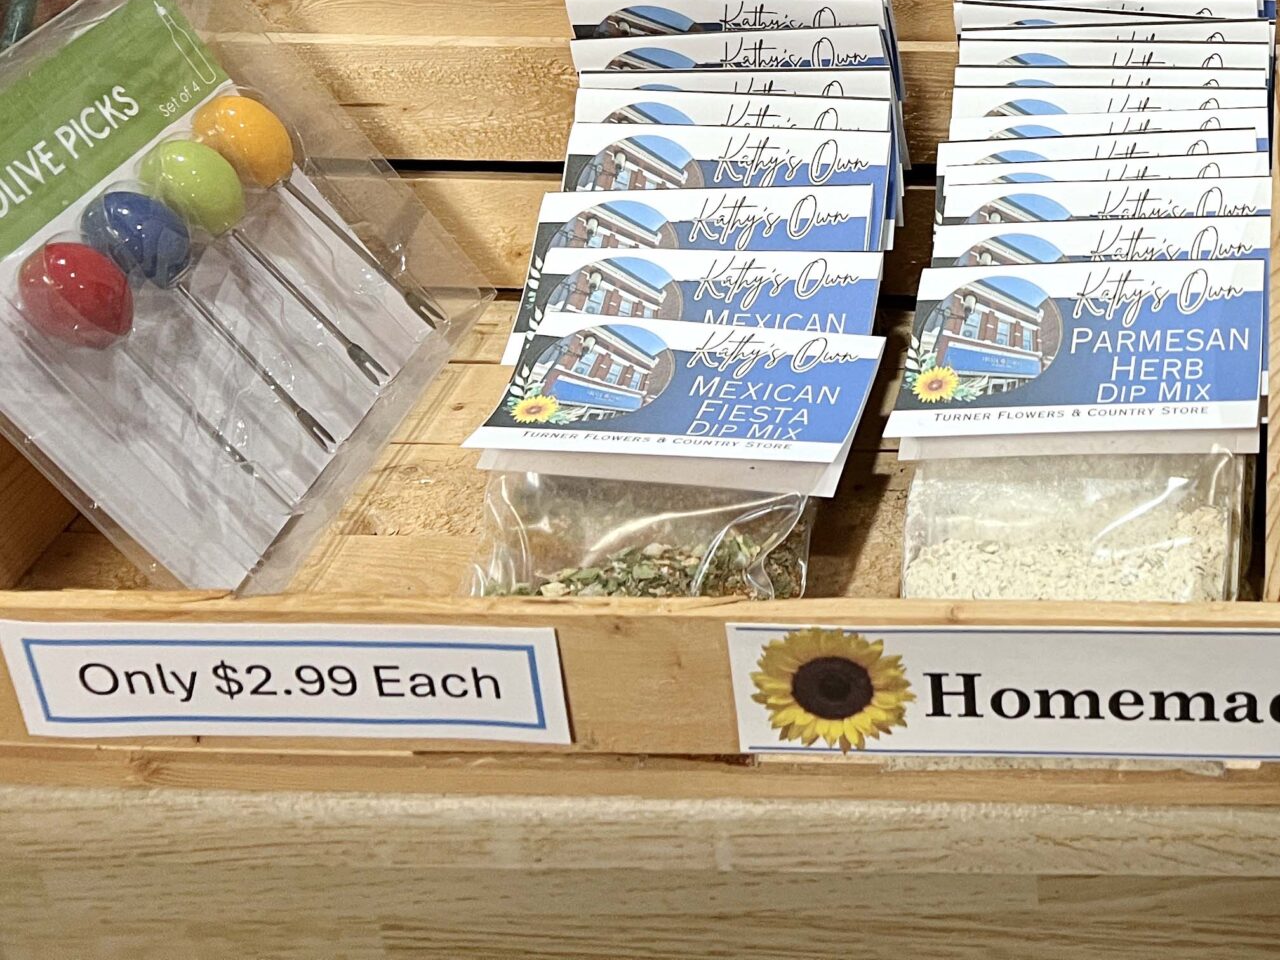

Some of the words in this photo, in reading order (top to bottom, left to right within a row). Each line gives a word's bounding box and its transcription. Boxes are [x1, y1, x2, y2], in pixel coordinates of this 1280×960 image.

[158, 101, 181, 119] Set
[179, 91, 193, 109] of
[192, 80, 201, 92] 4
[54, 84, 140, 160] PICKS
[712, 134, 802, 187] Kathy's
[808, 139, 869, 186] Own
[690, 194, 781, 250] Kathy's
[786, 194, 850, 240] Own
[694, 257, 789, 309] Kathy's
[794, 258, 860, 299] Own
[1071, 268, 1171, 328] Kathy's
[1178, 268, 1245, 314] Own
[703, 309, 846, 335] MEXICAN
[686, 332, 787, 378] Kathy's
[790, 337, 860, 373] Own
[1071, 327, 1249, 355] PARMESAN
[1110, 355, 1204, 382] HERB
[689, 376, 841, 405] MEXICAN
[1097, 383, 1146, 403] DIP
[1158, 382, 1211, 401] MIX
[695, 400, 809, 425] FIESTA
[935, 412, 991, 422] TURNER
[998, 410, 1065, 420] FLOWERS
[1072, 409, 1081, 417] &
[1088, 406, 1155, 417] COUNTRY
[1161, 406, 1209, 415] STORE
[522, 430, 579, 440] TURNER
[584, 434, 650, 443] FLOWERS
[672, 437, 740, 446] COUNTRY
[744, 441, 792, 450] STORE
[685, 421, 737, 438] DIP
[749, 424, 802, 441] MIX
[77, 661, 197, 703] Only
[212, 660, 358, 700] $2.99
[372, 664, 502, 700] Each
